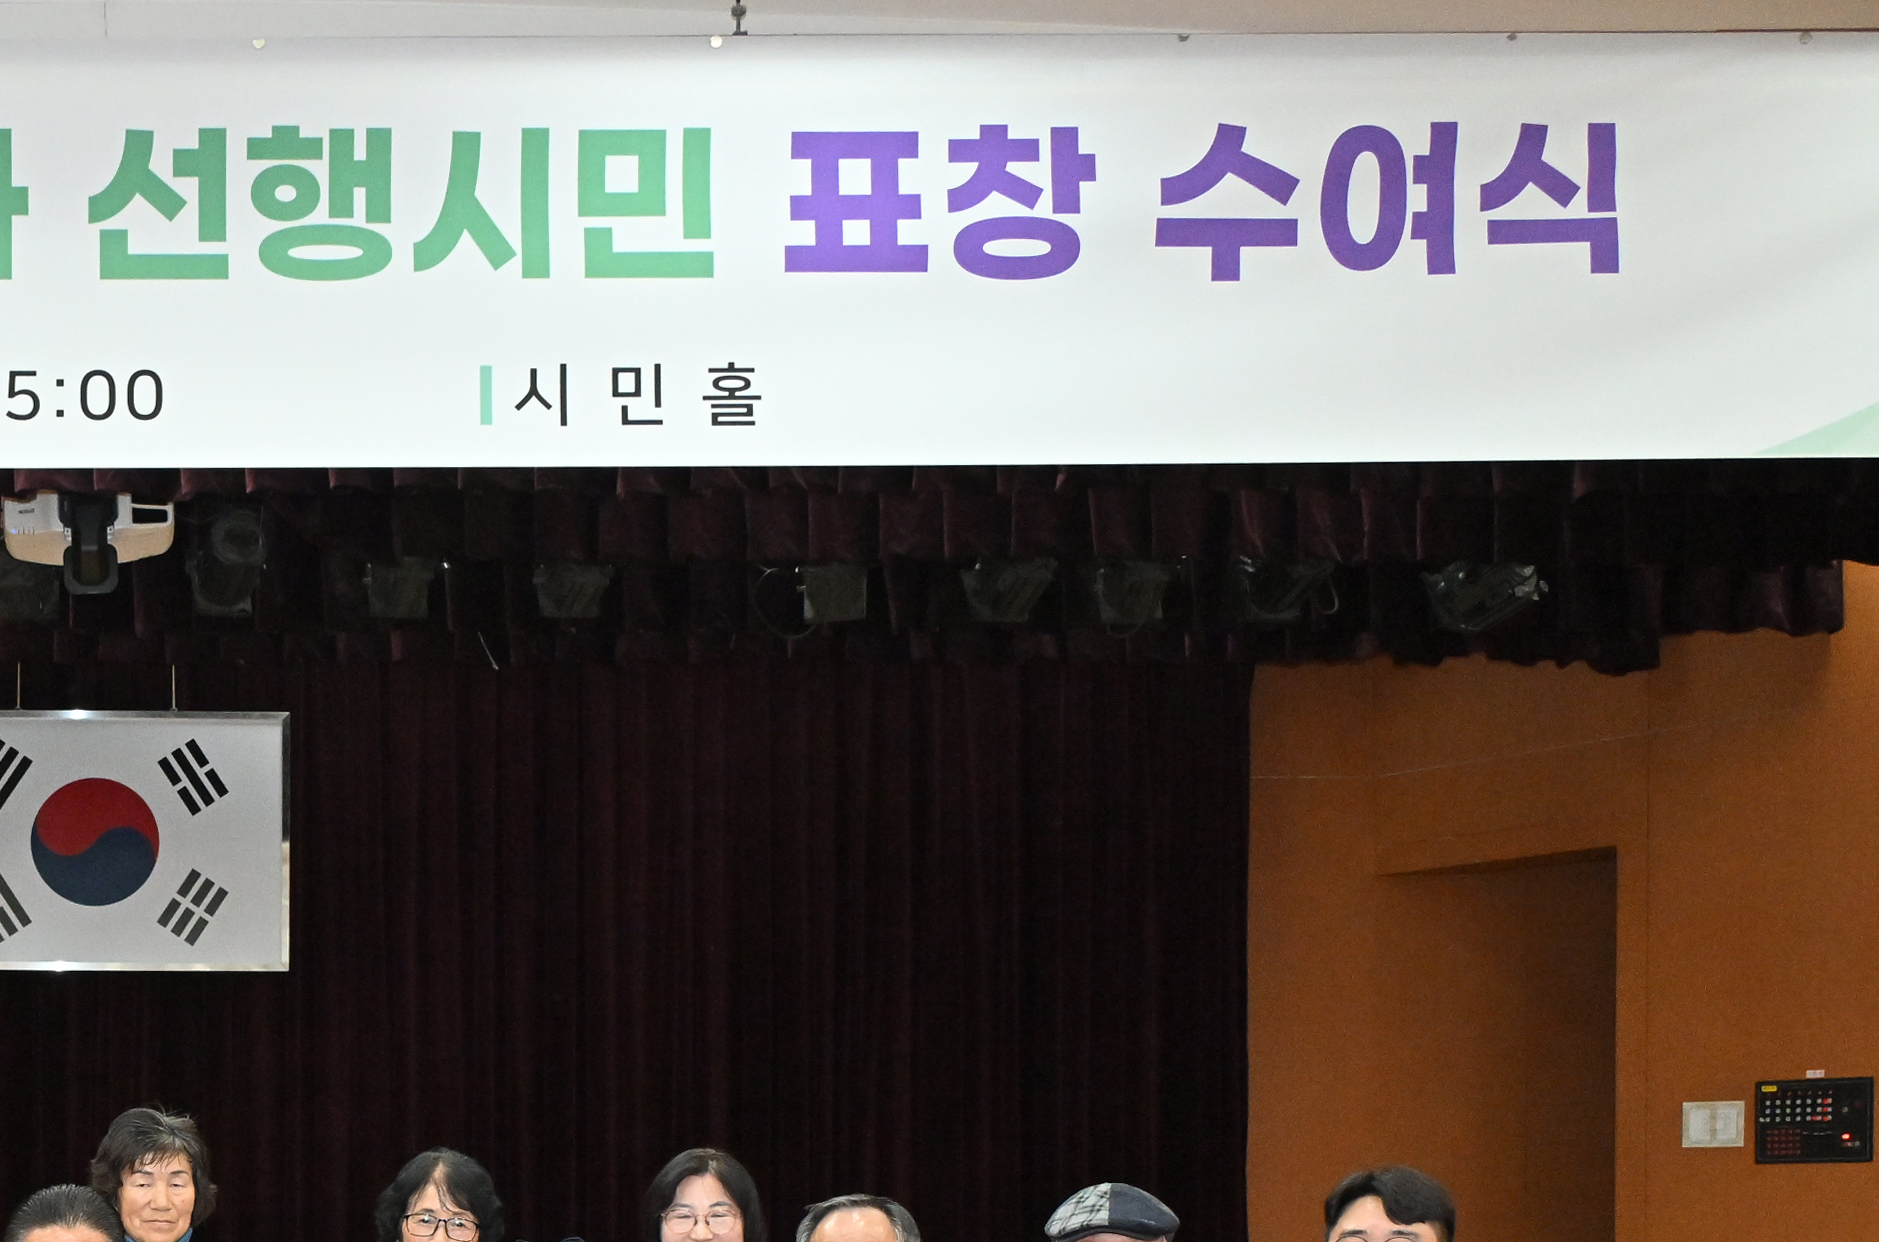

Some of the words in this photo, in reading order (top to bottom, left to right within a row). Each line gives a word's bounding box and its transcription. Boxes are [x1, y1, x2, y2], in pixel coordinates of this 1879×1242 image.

[88, 125, 715, 281] 선행시민
[784, 124, 1097, 281] 표창
[1155, 121, 1620, 282] 수여식
